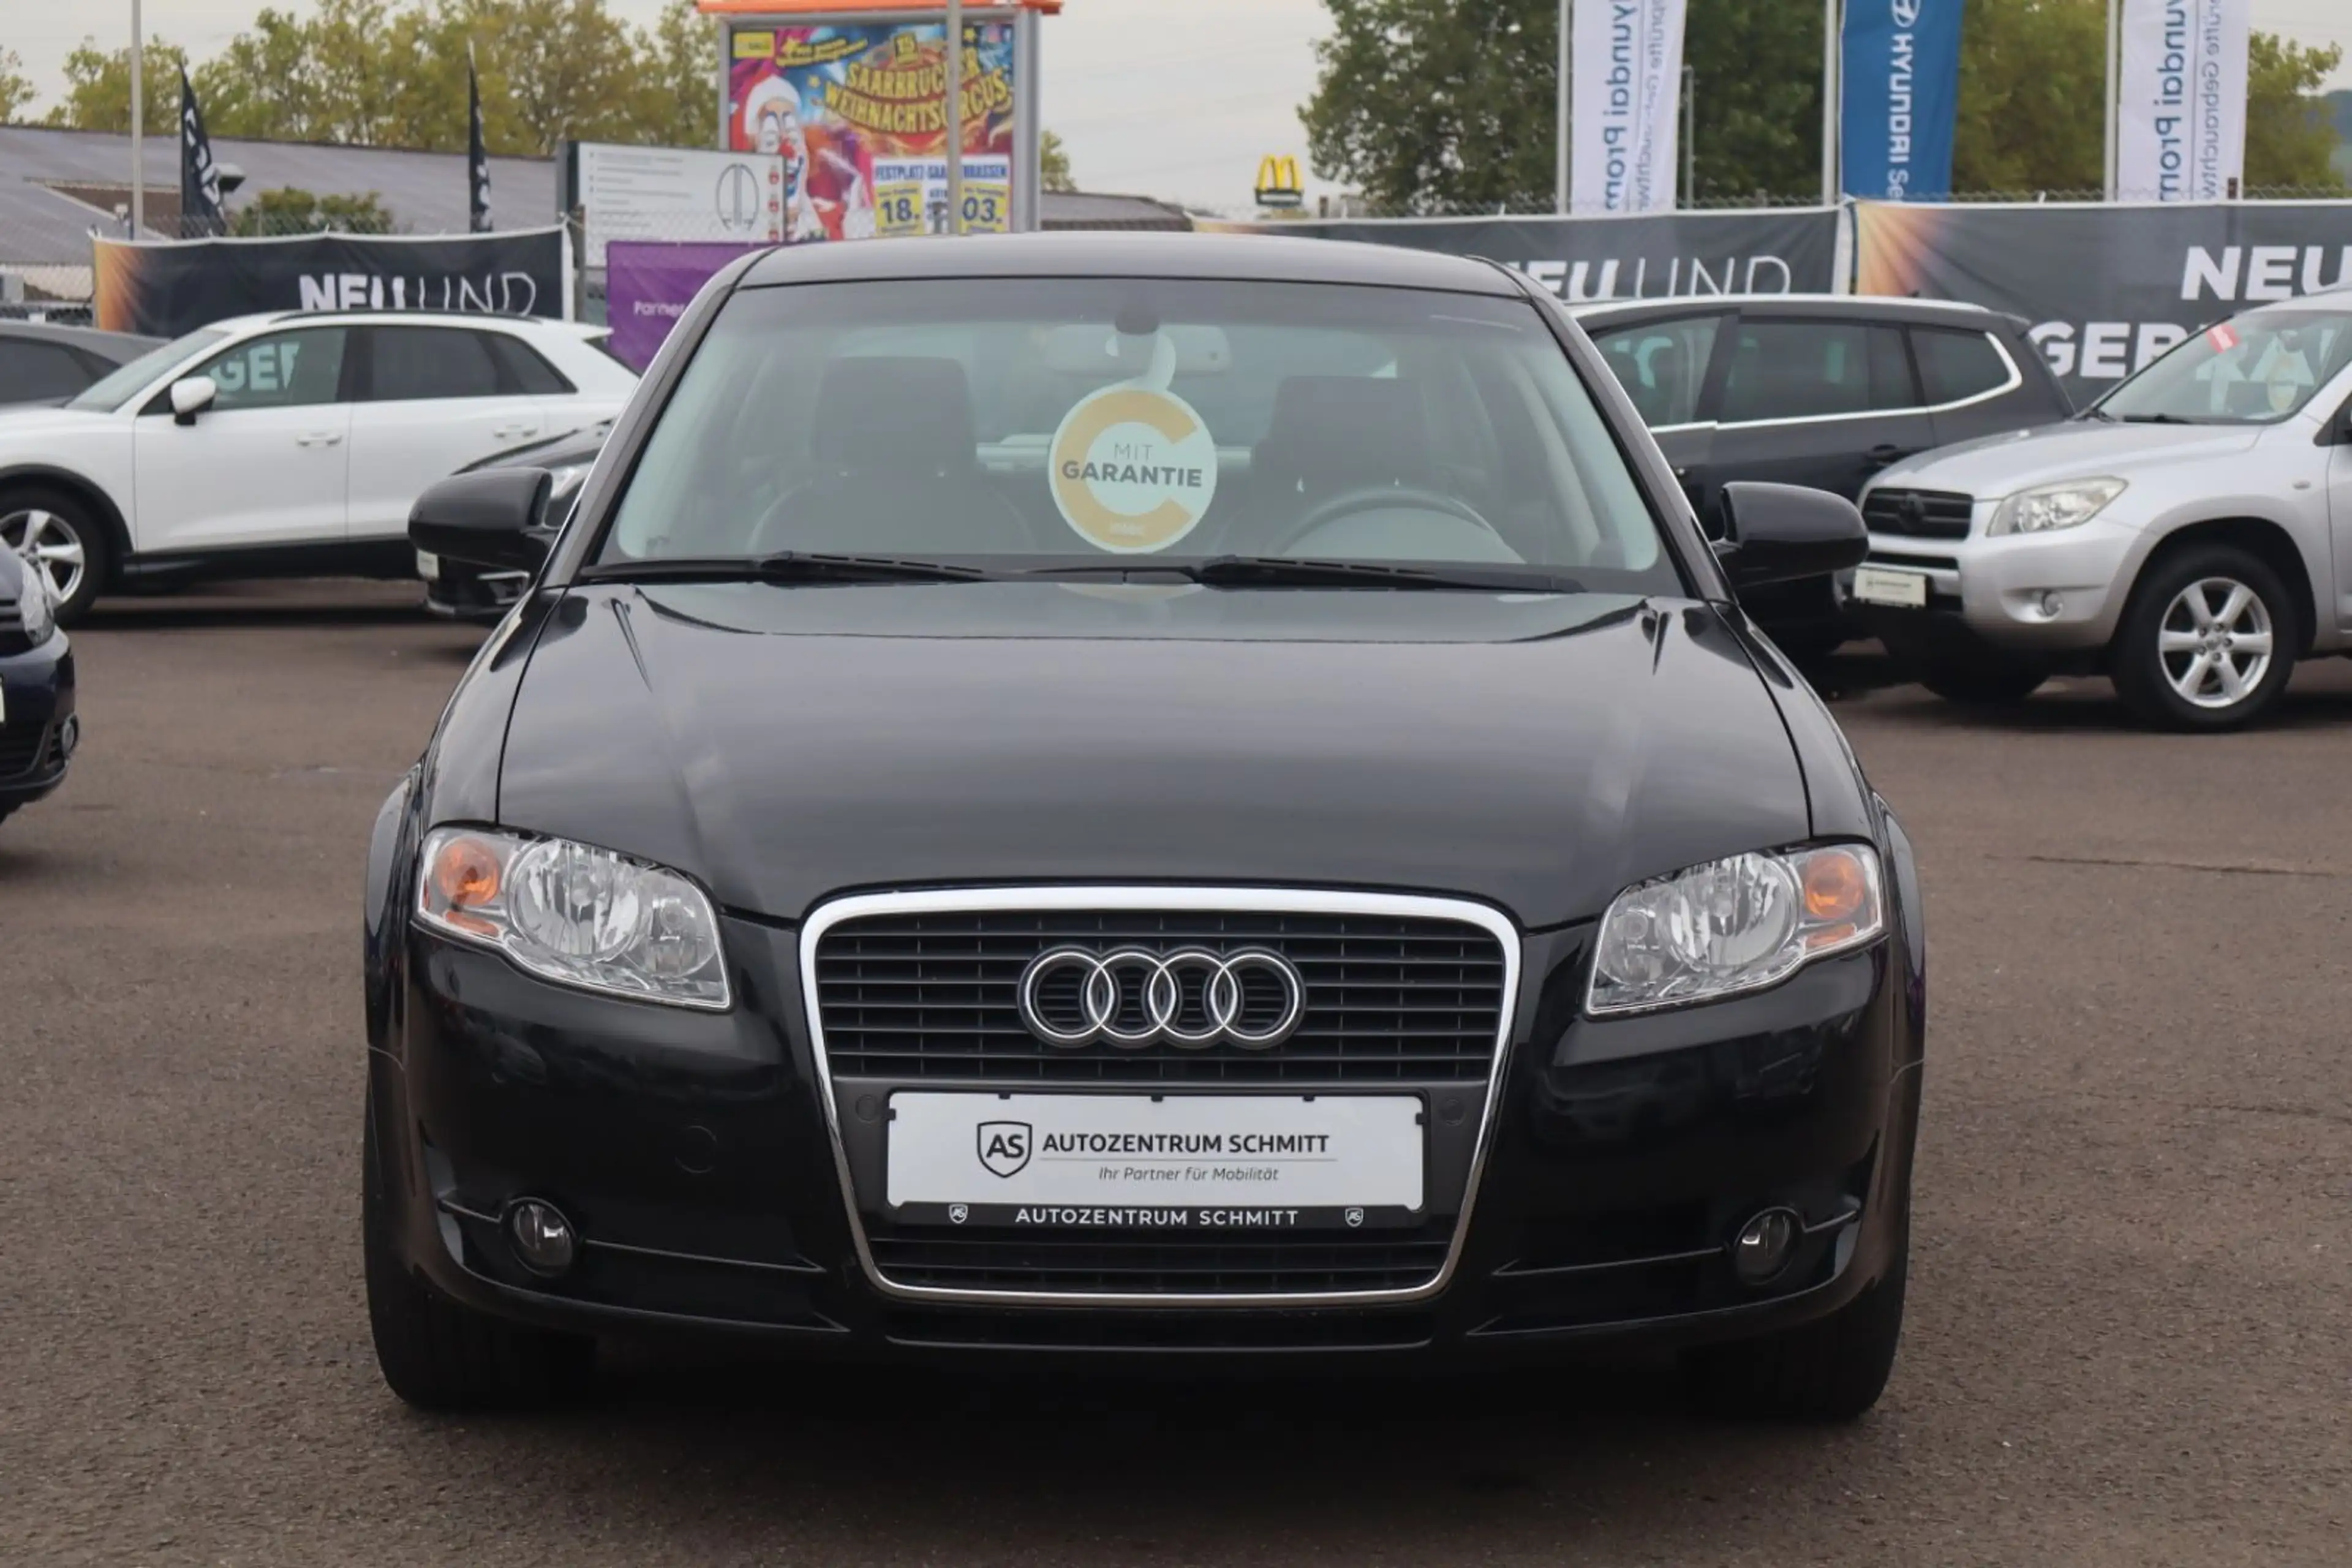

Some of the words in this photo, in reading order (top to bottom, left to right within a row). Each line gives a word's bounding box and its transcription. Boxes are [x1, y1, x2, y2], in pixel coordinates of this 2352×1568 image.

[824, 66, 1008, 133] WEIHNACHTSCRCUS
[1888, 33, 1914, 163] HYUNDAI
[1509, 258, 1620, 300] EU
[1114, 442, 1153, 461] MIT
[1061, 461, 1203, 488] GARANTIE
[986, 1134, 1025, 1159] AS
[1042, 1133, 1222, 1153] AUTOZENTRUM
[1229, 1134, 1330, 1153] SCHMITT
[1099, 1166, 1119, 1181] Ihr
[1124, 1167, 1180, 1182] Partner
[1185, 1166, 1208, 1182] für
[1212, 1167, 1280, 1182] Mobilität
[1014, 1208, 1188, 1224] AUTOZENTRUM
[1199, 1210, 1298, 1225] SCHMITT
